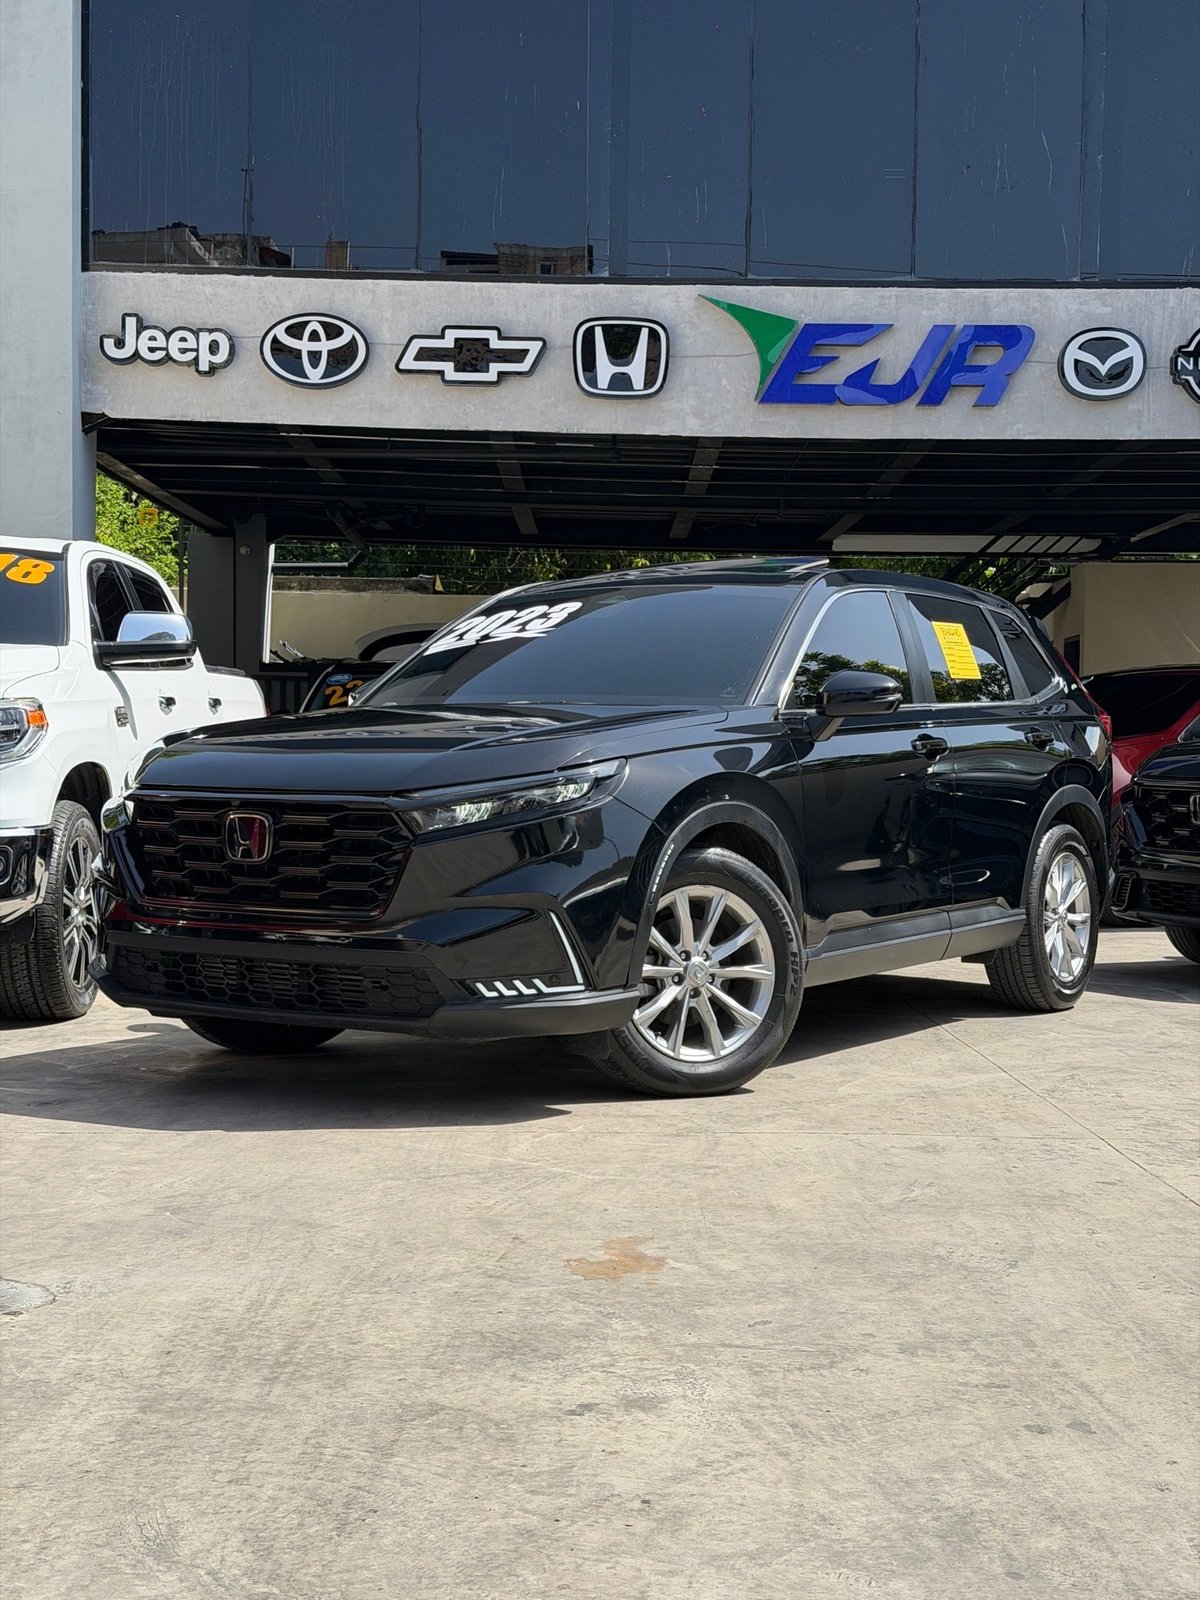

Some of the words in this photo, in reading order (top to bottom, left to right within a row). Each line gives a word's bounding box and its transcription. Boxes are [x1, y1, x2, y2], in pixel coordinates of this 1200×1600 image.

[101, 314, 233, 375] Jeep
[758, 322, 1035, 407] EJR
[424, 601, 583, 654] 2023
